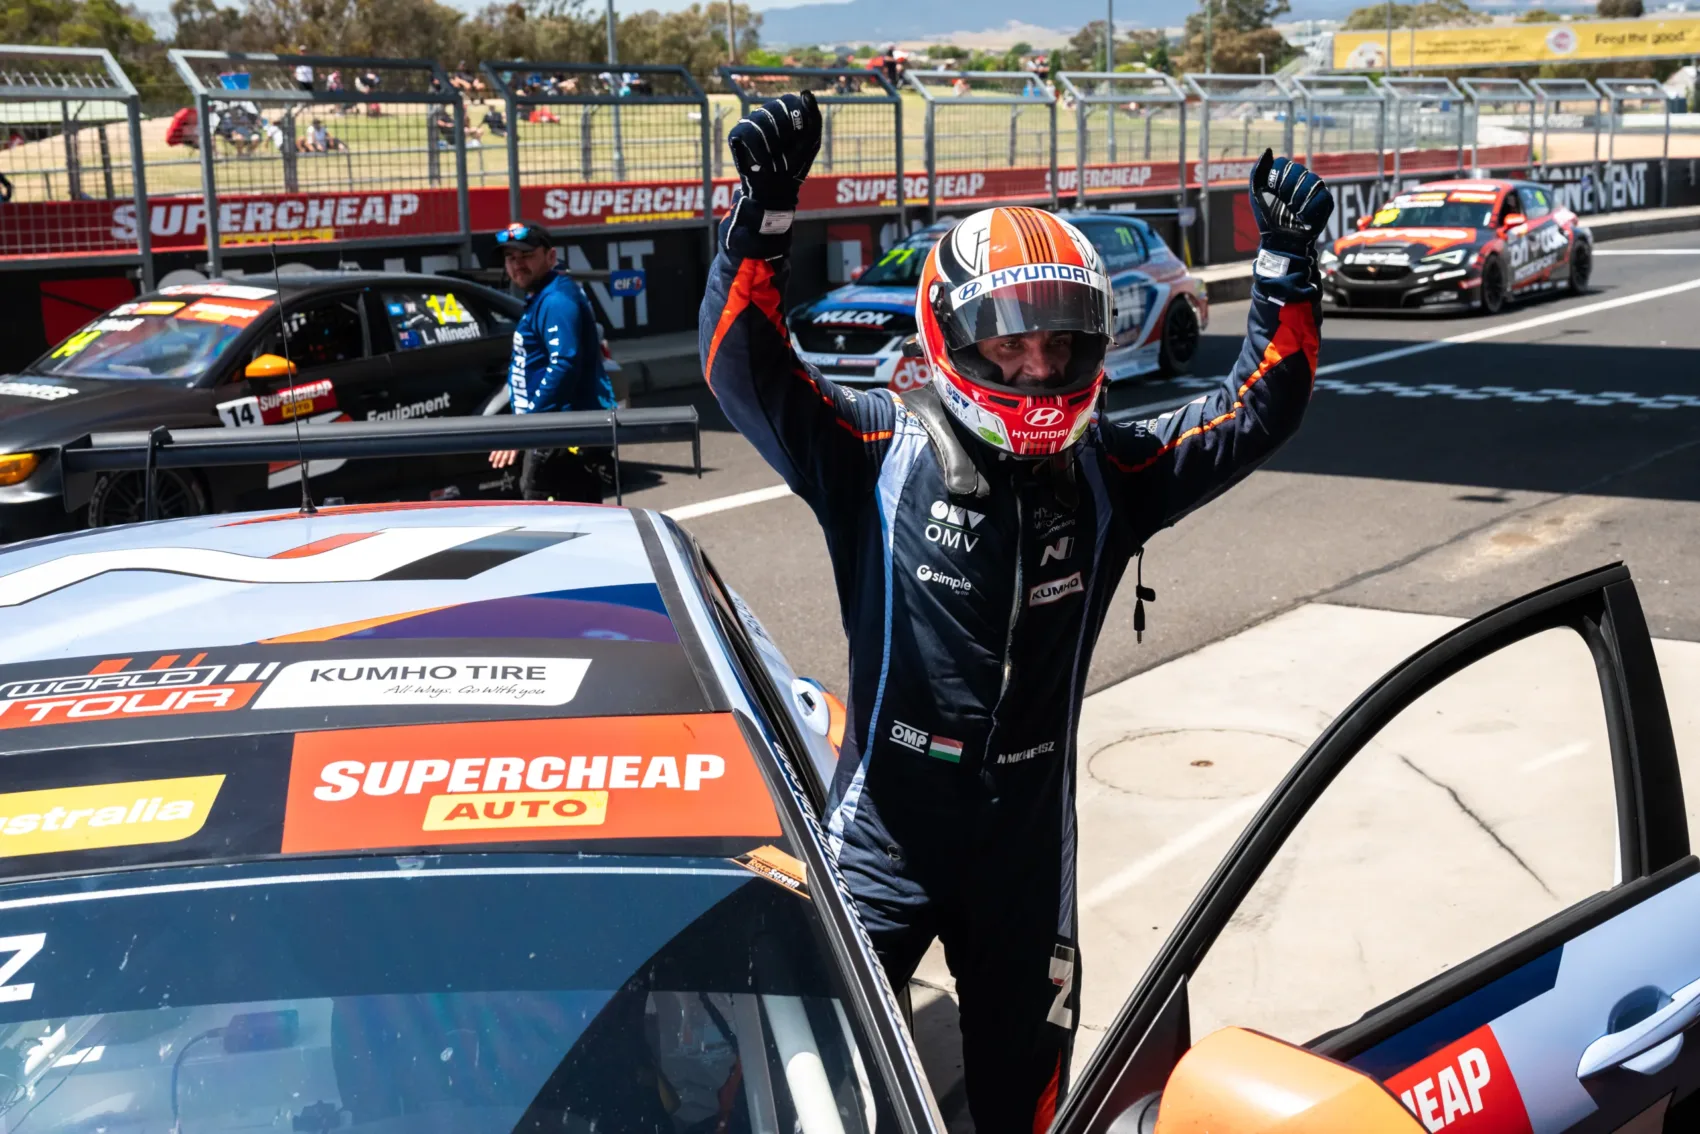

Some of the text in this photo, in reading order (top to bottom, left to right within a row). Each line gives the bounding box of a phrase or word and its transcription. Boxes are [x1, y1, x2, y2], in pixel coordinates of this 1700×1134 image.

[1268, 168, 1278, 188] OMP
[991, 265, 1092, 288] HYUNDAI
[425, 293, 462, 325] 14
[812, 310, 894, 325] NULON
[260, 380, 333, 411] SUPERCHEAP
[367, 392, 450, 421] Equipment
[227, 404, 255, 427] 14
[1011, 428, 1069, 440] HYUNDAI
[925, 524, 979, 553] OMV
[932, 571, 972, 590] simple
[1032, 578, 1079, 600] KUMHO
[6, 669, 202, 697] WORLD
[309, 665, 546, 682] KUMHO TIRE
[23, 687, 236, 722] TOUR
[891, 725, 927, 748] OMP
[313, 753, 725, 801] SUPERCHEAP
[443, 799, 587, 821] AUTO
[749, 858, 800, 889] RaceScreen
